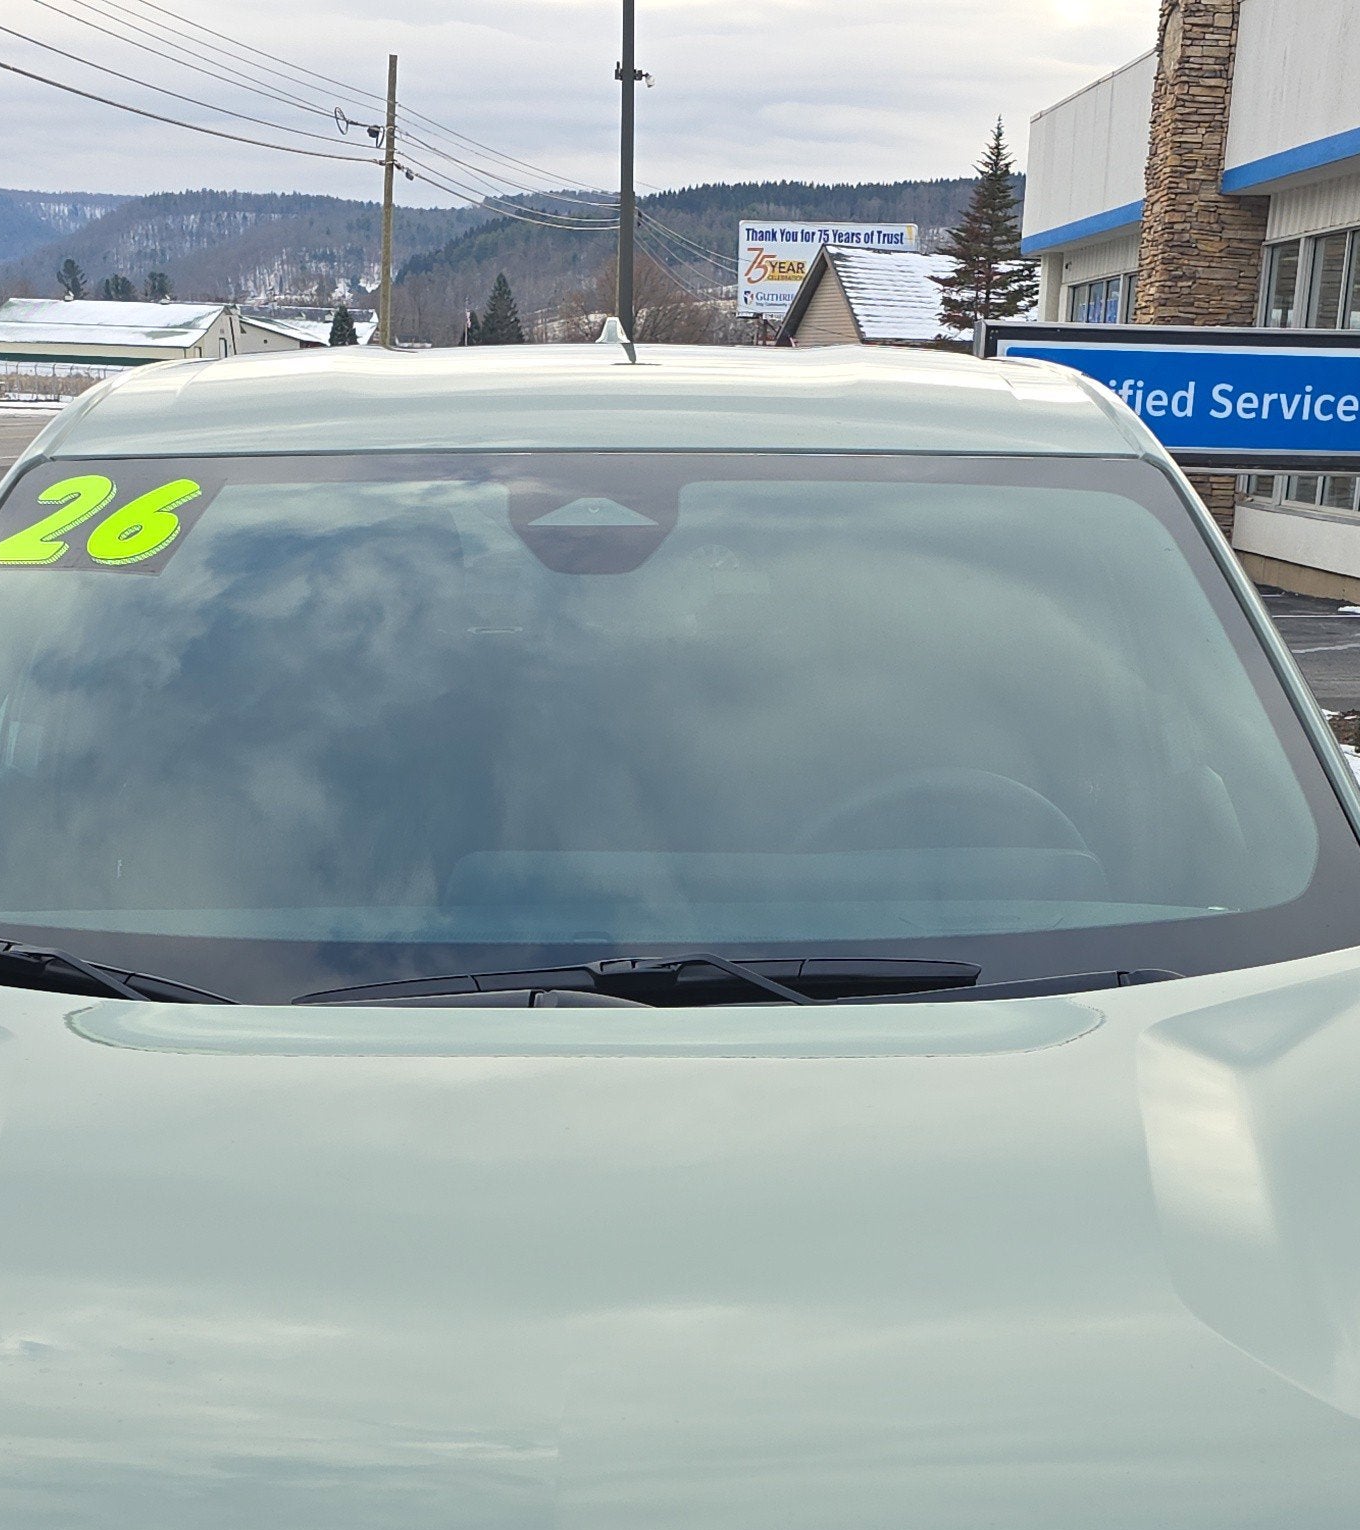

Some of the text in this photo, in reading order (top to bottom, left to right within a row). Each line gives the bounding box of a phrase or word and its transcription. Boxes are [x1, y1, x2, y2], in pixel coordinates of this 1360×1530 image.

[745, 228, 904, 245] Thank You for 75 Years of Trust
[744, 247, 805, 284] 75 YEAR
[1209, 383, 1359, 422] Service
